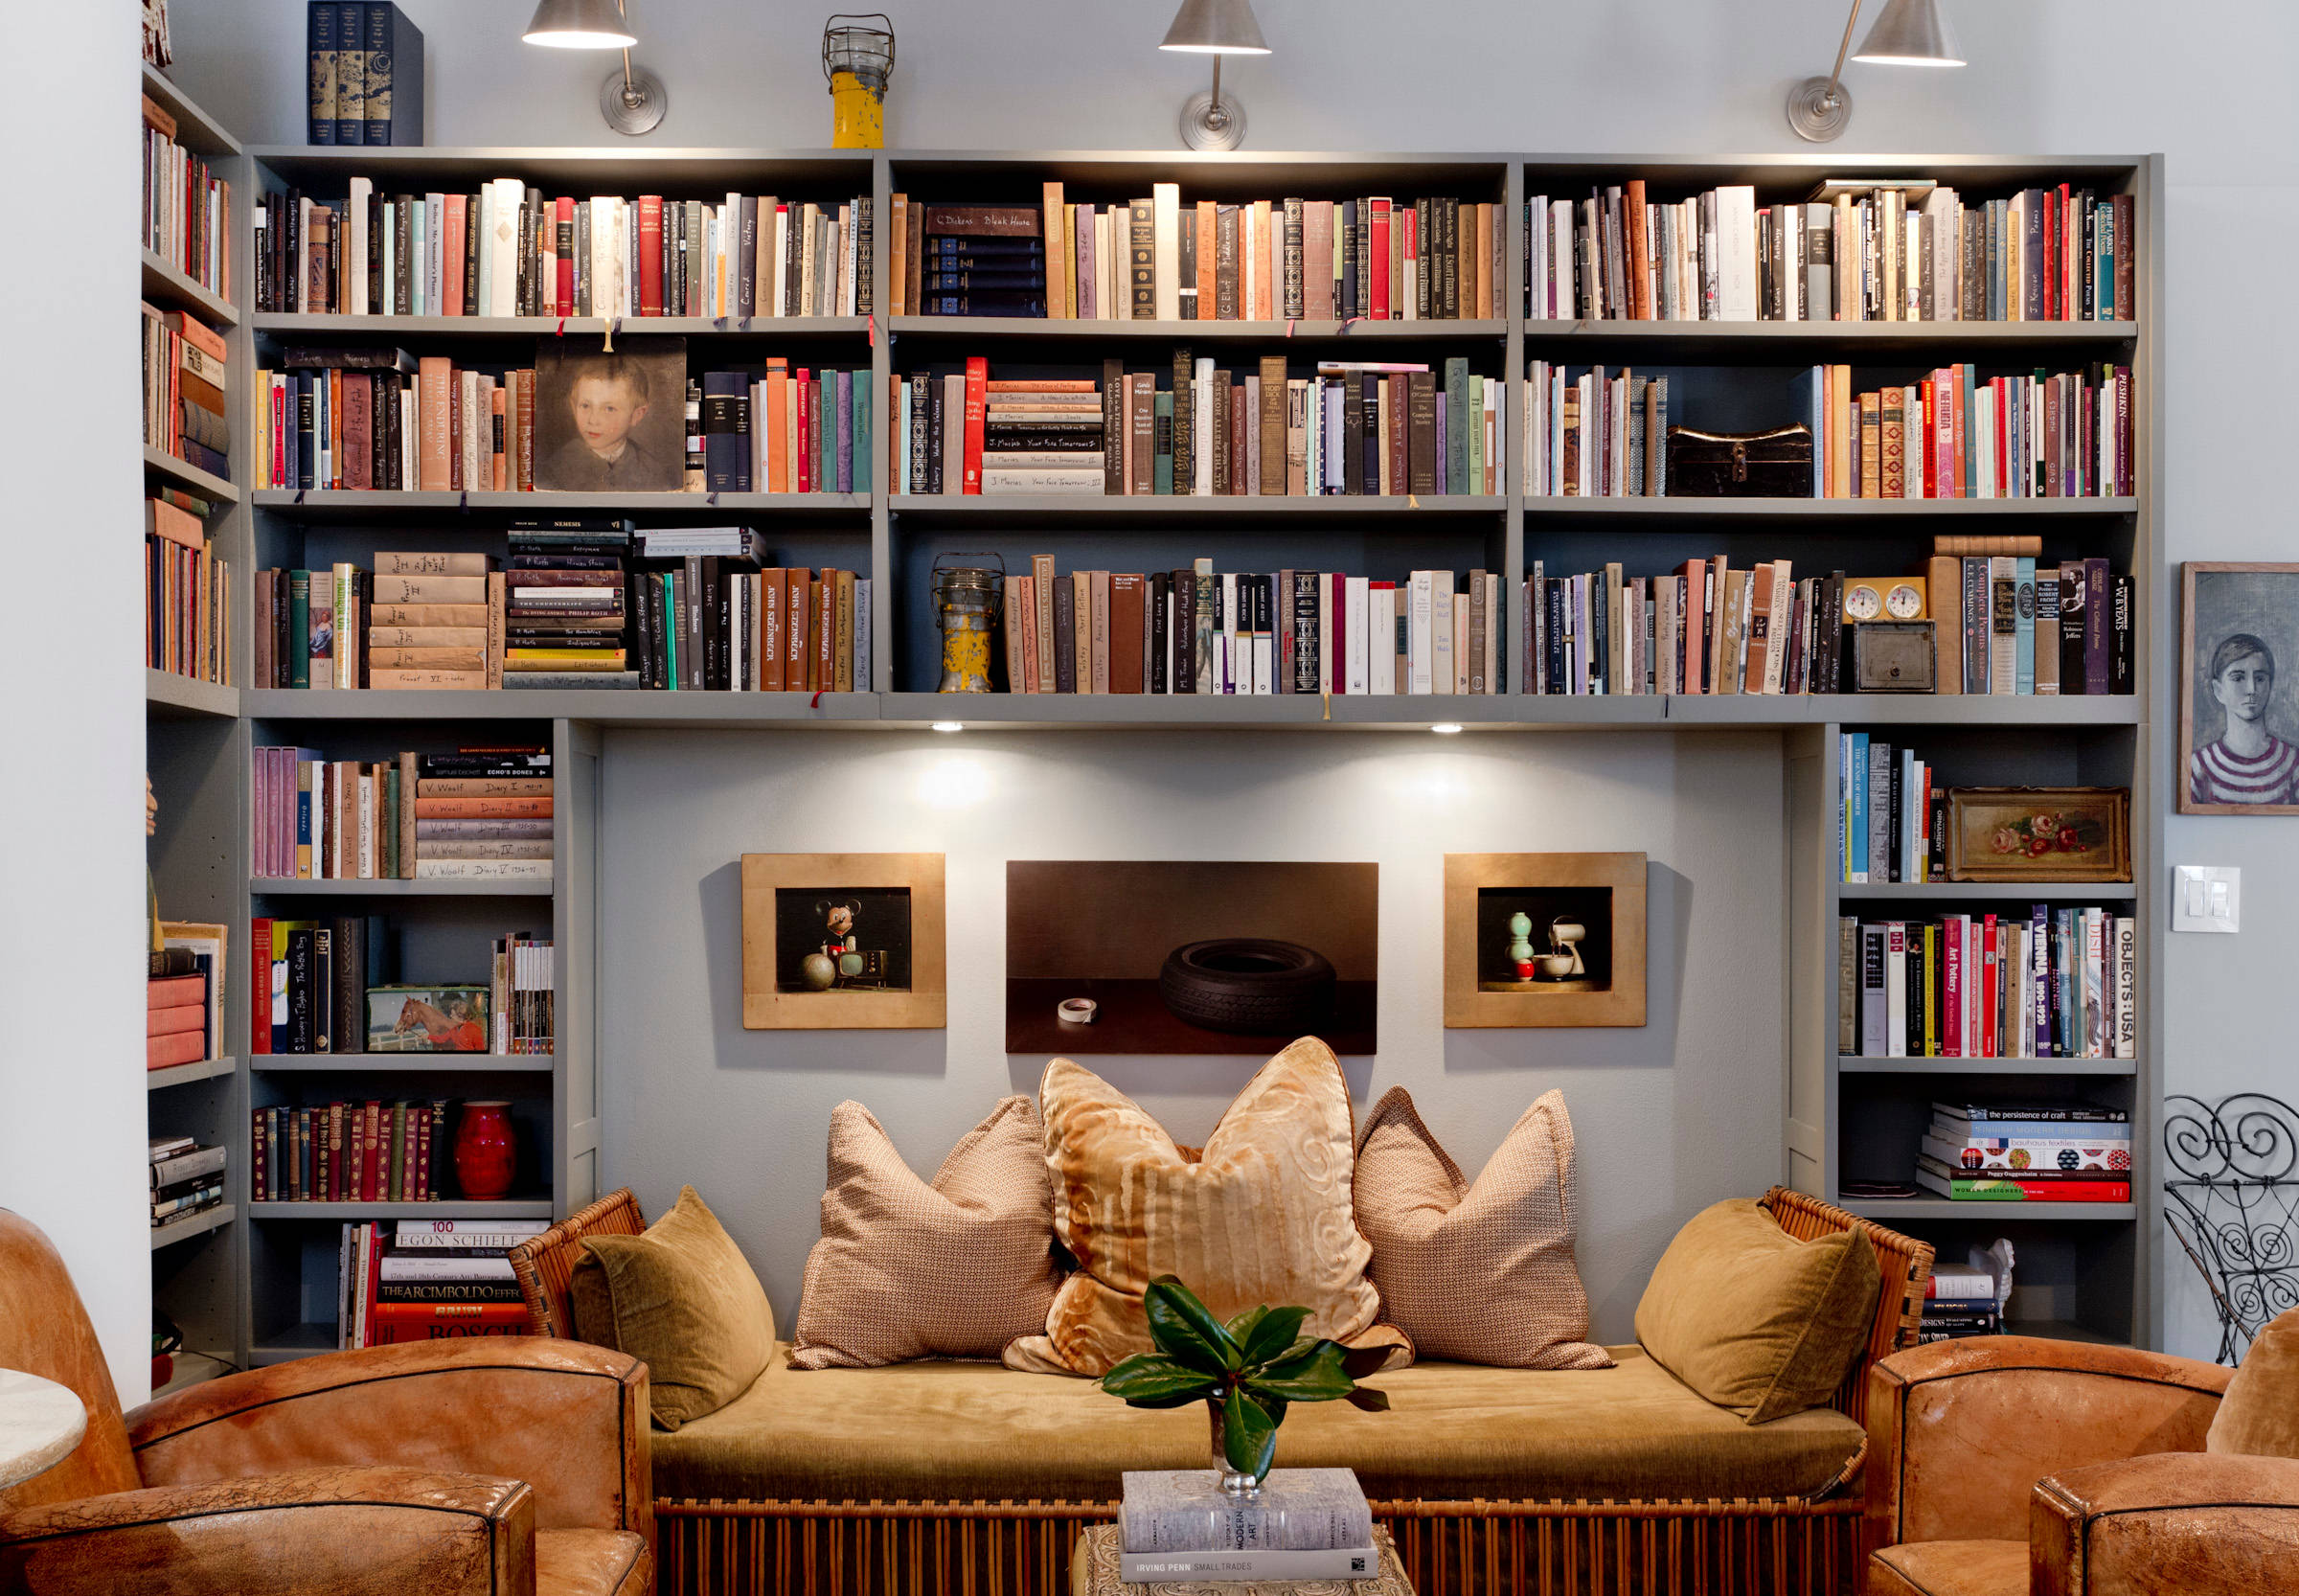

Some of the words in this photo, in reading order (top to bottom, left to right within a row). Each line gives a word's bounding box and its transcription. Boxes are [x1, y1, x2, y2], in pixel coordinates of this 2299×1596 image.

[947, 216, 973, 225] Dickens
[984, 215, 1008, 225] Bleak
[1010, 215, 1031, 227] House
[2030, 210, 2039, 234] Poems
[743, 219, 754, 245] Victory
[1220, 219, 1231, 264] Middlemarch
[1420, 262, 1428, 278] SCOTT
[1446, 260, 1454, 276] SCOTT
[1222, 280, 1230, 300] Eliot
[1420, 280, 1428, 311] FITZGERALD
[1446, 278, 1454, 310] FITZGERALD
[1221, 305, 1230, 313] G
[437, 373, 445, 396] THE
[1941, 390, 1951, 429] NERUDA
[436, 401, 445, 459] ENDURING
[588, 558, 604, 566] Stain
[412, 584, 420, 595] II
[1977, 565, 1988, 613] Complete
[2115, 606, 2124, 630] YEATS
[1978, 617, 1987, 649] Poems
[426, 784, 435, 792] V.
[438, 783, 464, 791] Woolf
[485, 783, 507, 795] Diary
[481, 804, 502, 812] Diary
[441, 824, 461, 832] Woolf
[501, 845, 513, 854] IV
[428, 866, 436, 875] V.
[441, 865, 465, 875] Woolf
[473, 865, 497, 875] Diary
[2090, 924, 2101, 958] DISH
[1948, 947, 1957, 961] Art
[2034, 923, 2048, 977] VIENNA
[2122, 931, 2133, 1001] OBJECTS
[296, 972, 305, 983] The
[1947, 964, 1958, 993] Pottery
[2037, 981, 2045, 1025] 1890-1920
[2122, 1012, 2133, 1043] USA
[431, 1221, 454, 1232] 100
[400, 1235, 444, 1246] EGON
[453, 1235, 518, 1246] SCHIELE
[383, 1287, 403, 1296] THE
[403, 1286, 493, 1298] ARCIMBOLDO
[435, 1306, 482, 1318] GAUDI
[1920, 1319, 1945, 1327] DESIGNS
[1136, 1563, 1165, 1572] IRVING
[1167, 1563, 1190, 1571] PENN
[1194, 1563, 1219, 1571] SMALL
[1221, 1562, 1251, 1571] TRADES
